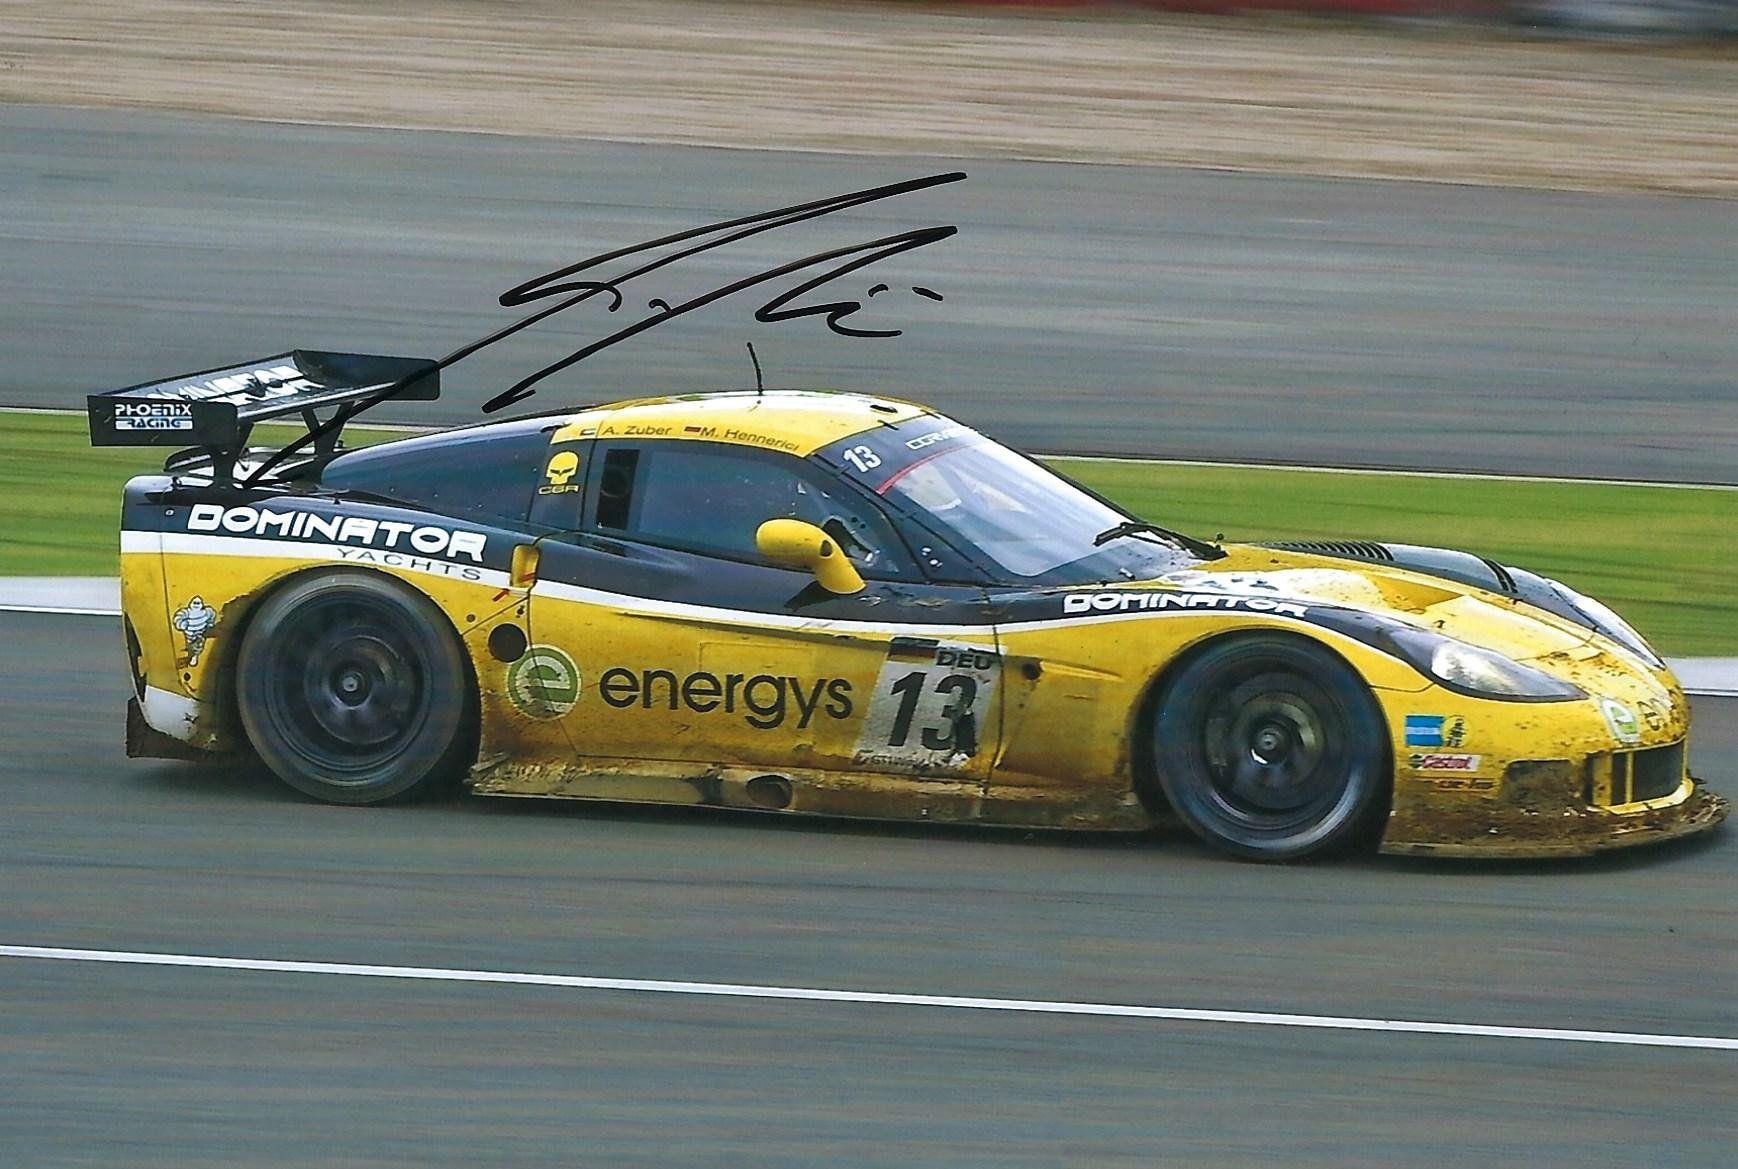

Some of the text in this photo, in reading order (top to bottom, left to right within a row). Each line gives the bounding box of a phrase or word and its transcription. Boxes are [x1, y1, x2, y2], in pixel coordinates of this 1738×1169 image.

[114, 403, 192, 416] PHOENIX
[602, 425, 673, 435] A. Zuber
[724, 429, 800, 451] Hennerici
[842, 445, 882, 473] 13
[187, 503, 488, 562] DOMINATOR
[336, 547, 482, 582] YACHTS
[1063, 592, 1309, 618] DOMINATOR
[599, 667, 853, 729] energys
[888, 671, 978, 751] 13
